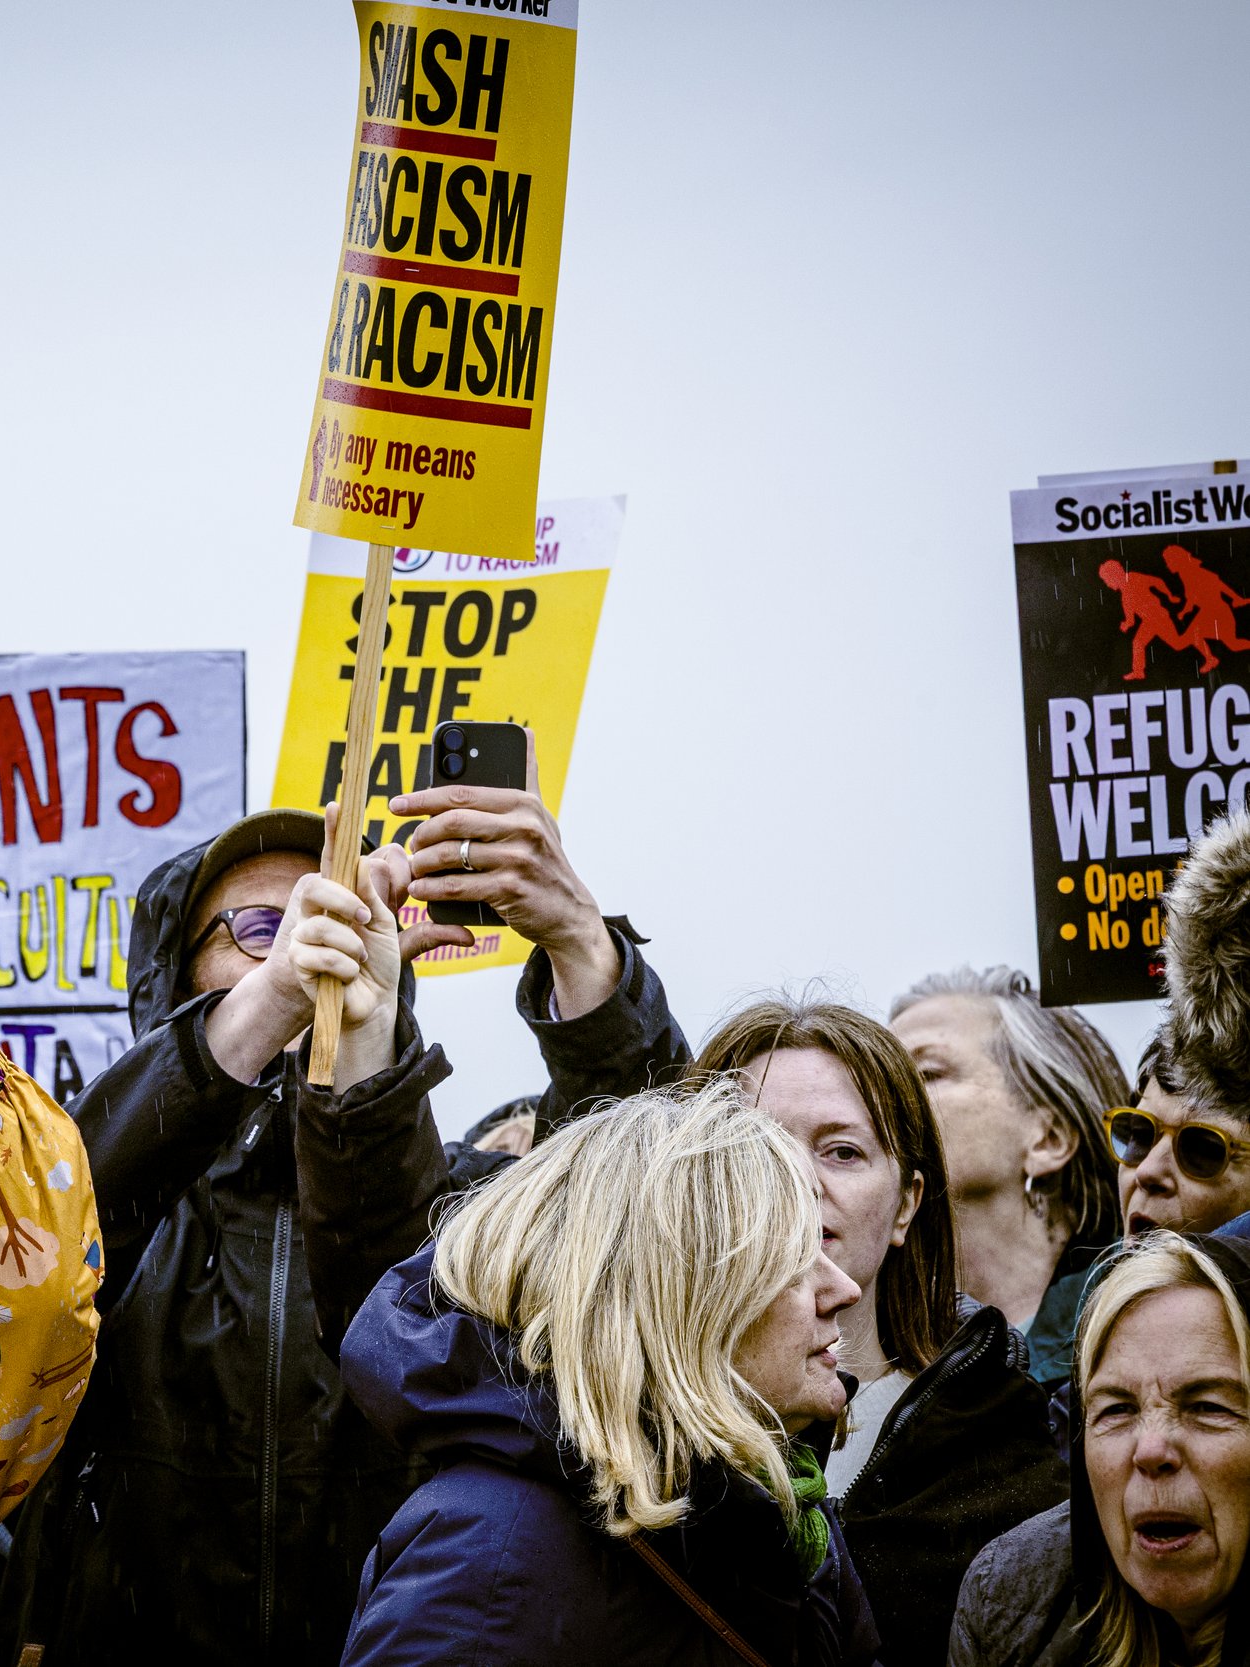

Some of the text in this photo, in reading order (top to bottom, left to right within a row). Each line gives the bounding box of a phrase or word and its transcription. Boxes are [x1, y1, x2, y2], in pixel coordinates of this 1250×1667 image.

[365, 20, 510, 133] SMASH
[350, 149, 532, 268] FASCISM
[328, 278, 543, 401] & RACISM
[328, 419, 476, 481] By any means
[322, 475, 425, 530] necessary
[1055, 489, 1209, 533] Socialist
[1049, 683, 1250, 777] REFUG
[1050, 768, 1250, 862] WELC
[1084, 863, 1164, 905] Open
[1088, 911, 1130, 950] No
